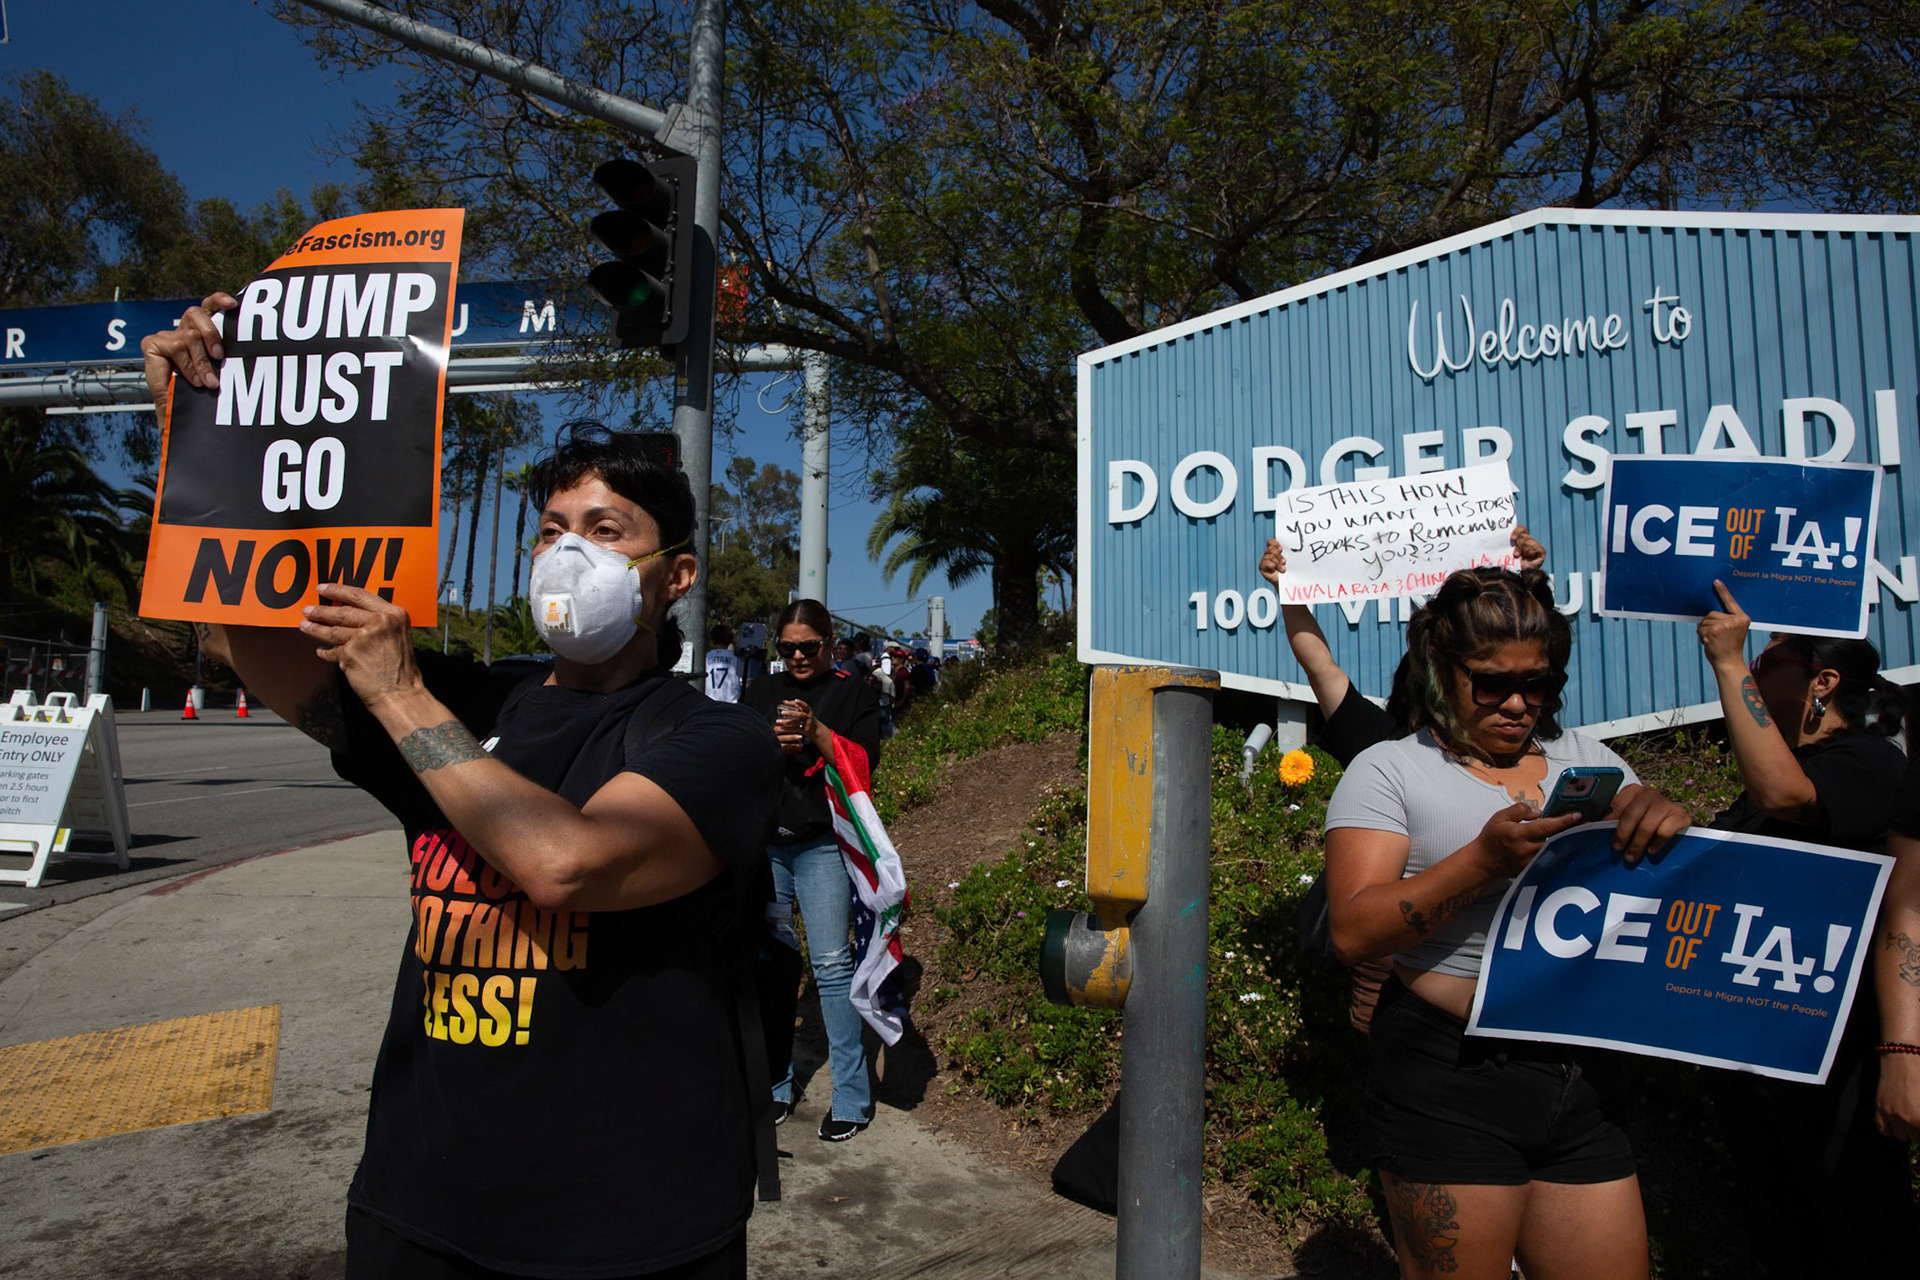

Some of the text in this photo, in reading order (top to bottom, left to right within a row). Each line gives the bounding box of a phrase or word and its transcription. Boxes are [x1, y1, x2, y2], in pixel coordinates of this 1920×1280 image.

[211, 272, 436, 342] RUMP
[1408, 286, 1692, 378] Welcome to
[215, 352, 403, 426] MUST
[1108, 389, 1901, 524] DODGER STADI
[261, 437, 346, 513] GO
[1287, 492, 1315, 514] IS
[1318, 485, 1386, 510] THIS
[1344, 507, 1416, 529] WANT
[1433, 494, 1516, 518] HISTORY
[1409, 515, 1515, 543] Remember
[1612, 504, 1862, 570] ICE OUT OF LA!
[184, 538, 404, 610] NOW!
[1732, 569, 1760, 579] Deport
[1771, 572, 1793, 582] Migra
[1794, 575, 1812, 583] NOT
[1829, 578, 1857, 587] People
[1188, 588, 1313, 630] 100
[709, 667, 728, 689] 17
[1, 731, 69, 747] Employee
[31, 750, 65, 763] ONLY
[9, 782, 23, 790] 2.5
[25, 783, 48, 792] hours
[26, 772, 49, 780] gates
[11, 795, 21, 803] to
[22, 795, 39, 803] first
[1503, 885, 1852, 994] ICE OUT OF LA!
[422, 968, 537, 1047] LESS!
[1665, 982, 1828, 1018] Deport la Migra NOT the People
